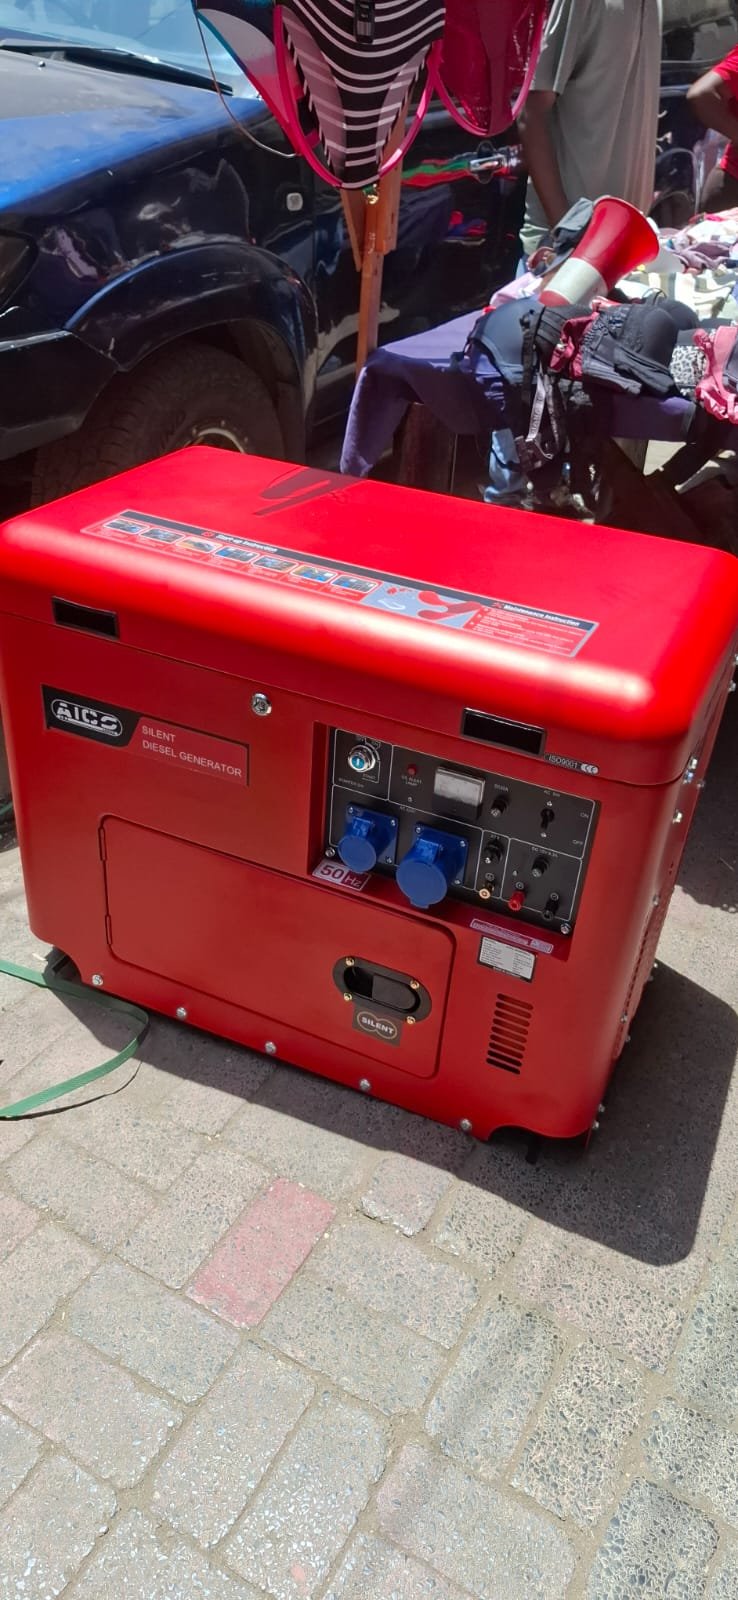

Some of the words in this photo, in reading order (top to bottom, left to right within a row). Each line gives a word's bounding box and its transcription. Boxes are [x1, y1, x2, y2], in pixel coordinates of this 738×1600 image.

[141, 725, 176, 743] SILENT
[142, 740, 177, 758] DIESEL
[179, 751, 242, 777] GENERATOR
[548, 754, 578, 770] ISO9001
[320, 864, 345, 881] 50
[345, 874, 362, 888] Hz
[361, 1016, 394, 1035] SILENT
